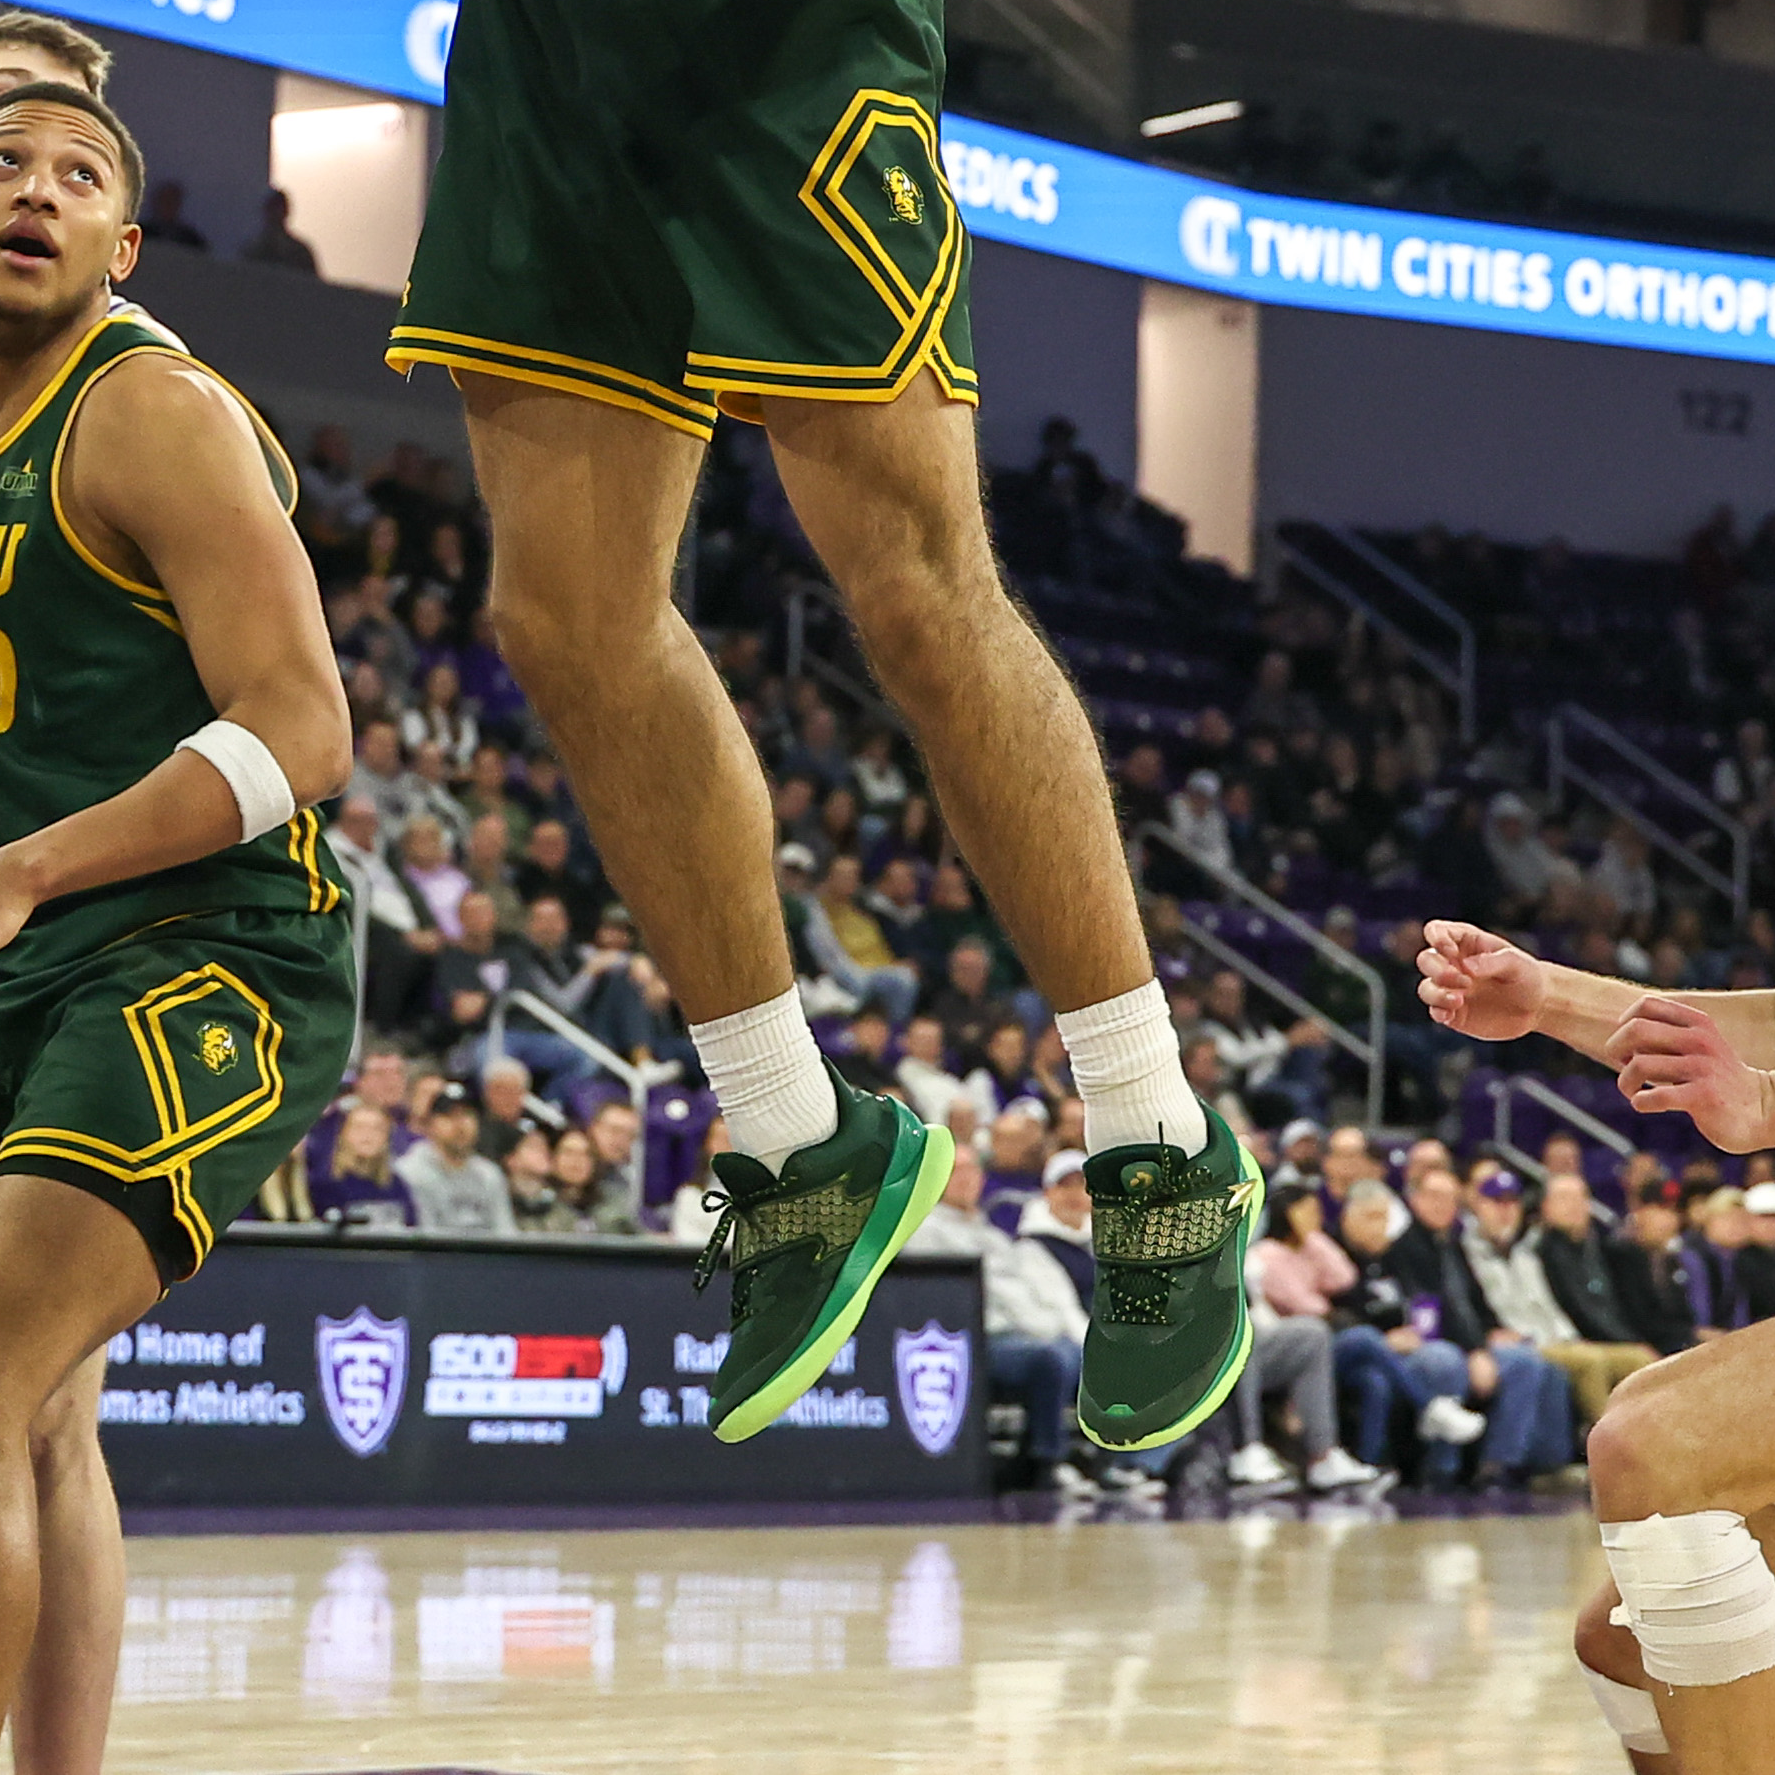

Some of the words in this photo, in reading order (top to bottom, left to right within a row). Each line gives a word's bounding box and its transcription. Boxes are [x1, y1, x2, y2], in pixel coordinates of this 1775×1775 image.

[1246, 217, 1383, 291] TWIN
[1391, 237, 1553, 312] CITIES
[135, 1324, 227, 1366] Home
[229, 1323, 266, 1366] of
[175, 1380, 306, 1425] Athletics
